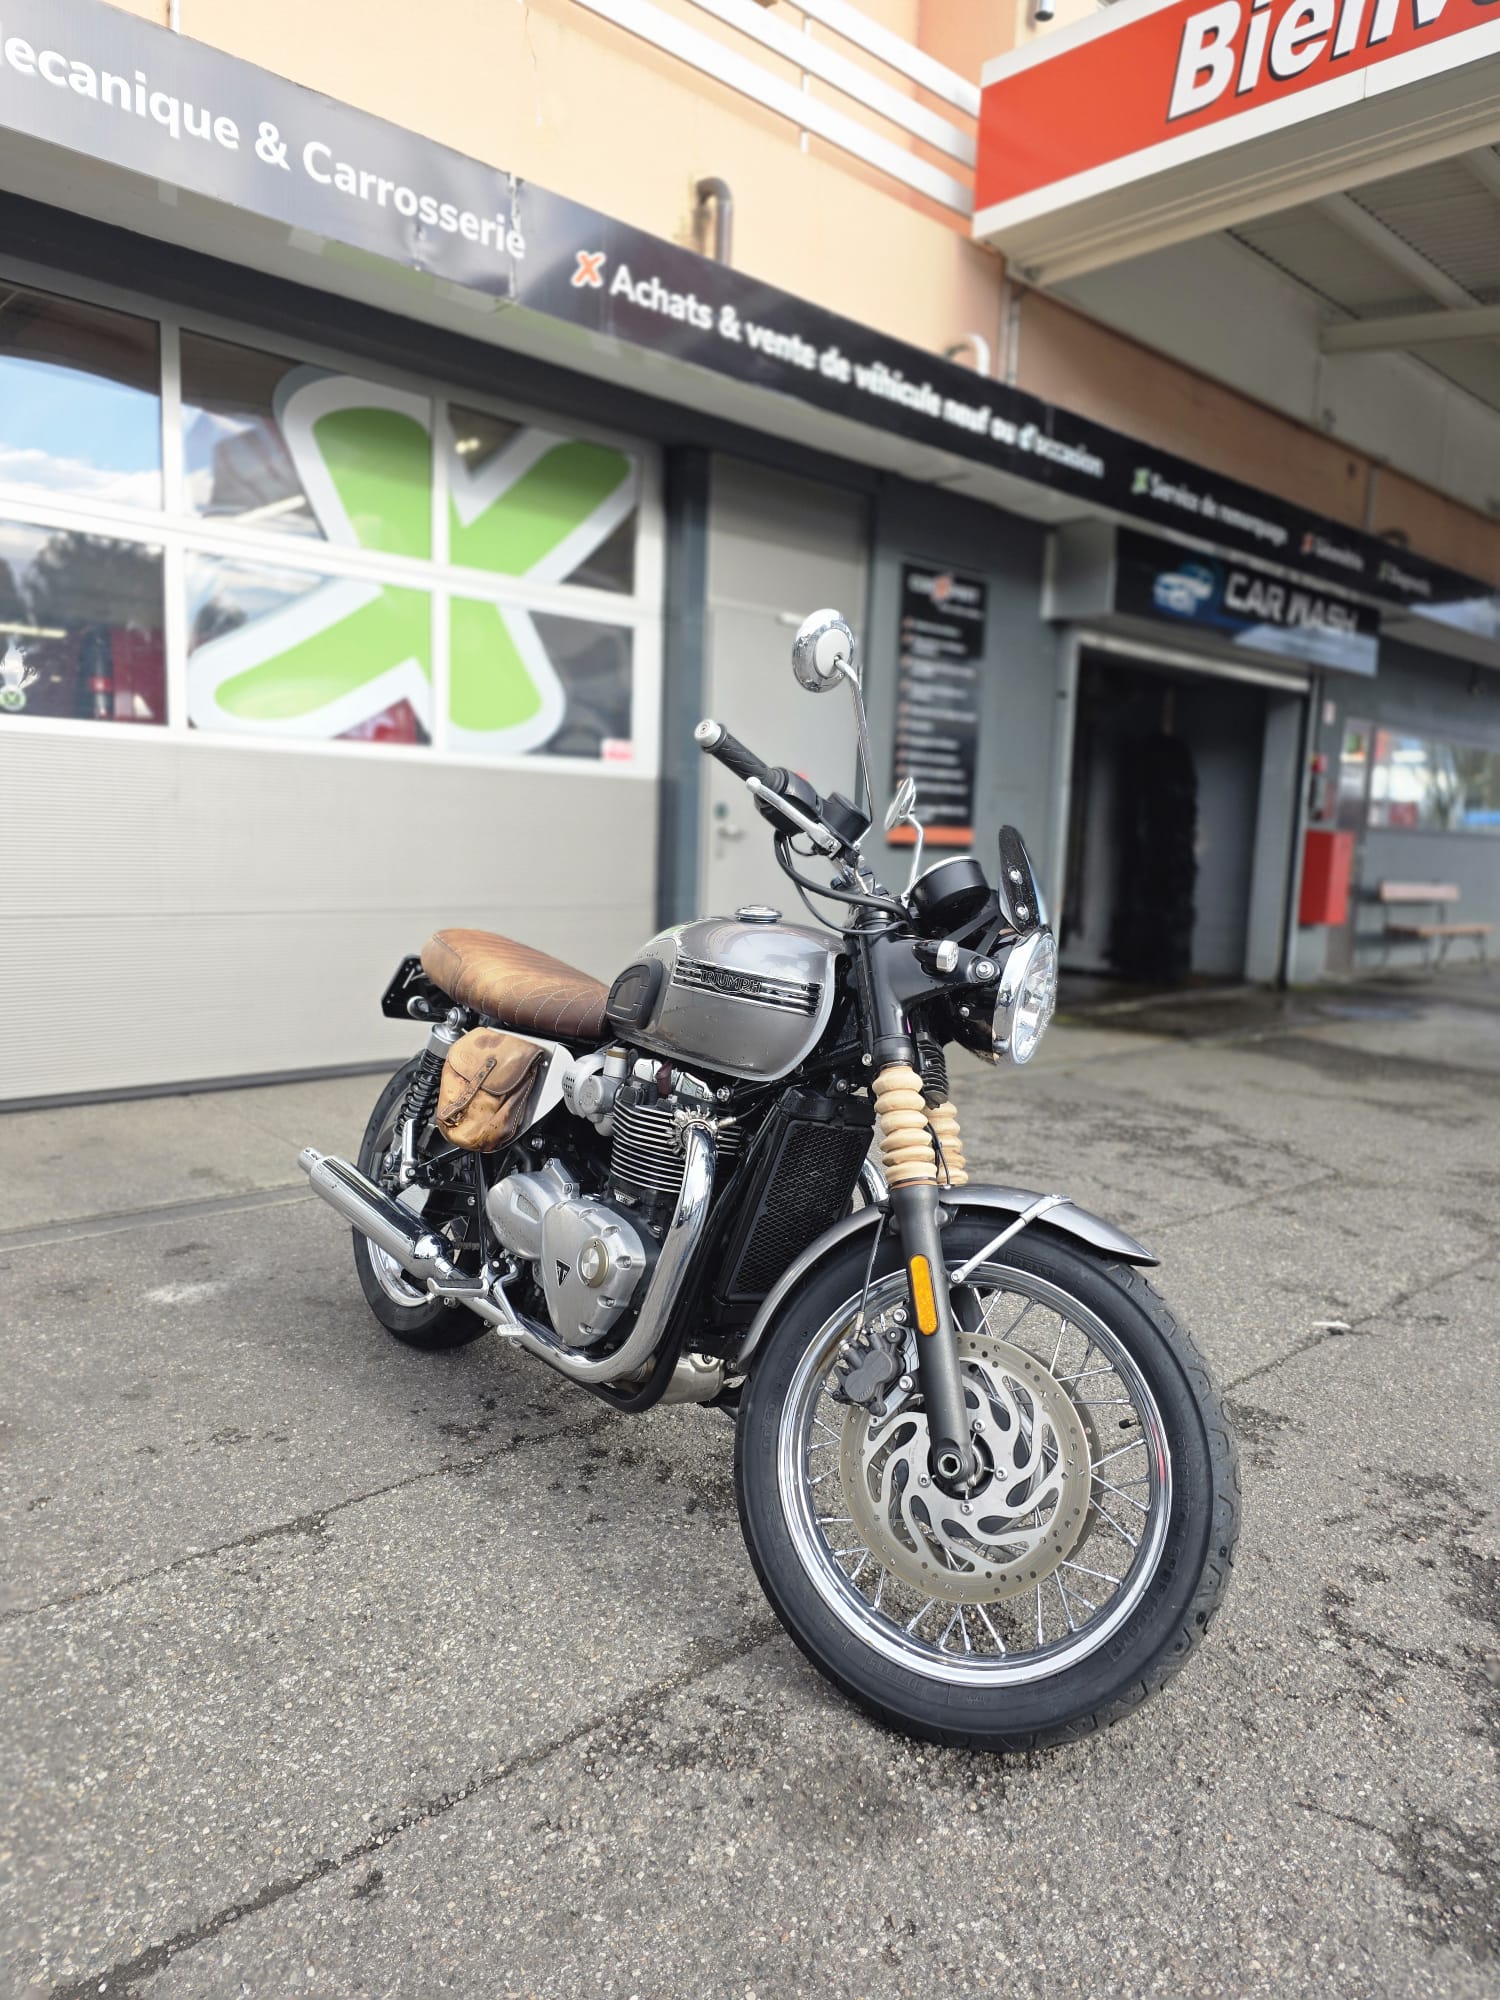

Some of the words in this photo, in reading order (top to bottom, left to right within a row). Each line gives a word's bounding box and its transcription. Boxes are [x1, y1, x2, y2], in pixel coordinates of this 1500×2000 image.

[0, 20, 240, 150] ecanique
[255, 121, 291, 171] &
[303, 141, 525, 259] Carrosserie
[610, 264, 713, 330] Achats
[718, 304, 743, 343] &
[744, 321, 816, 370] vente
[818, 346, 851, 384] de
[1223, 572, 1284, 623] CAR
[699, 970, 763, 993] TRIUMPH
